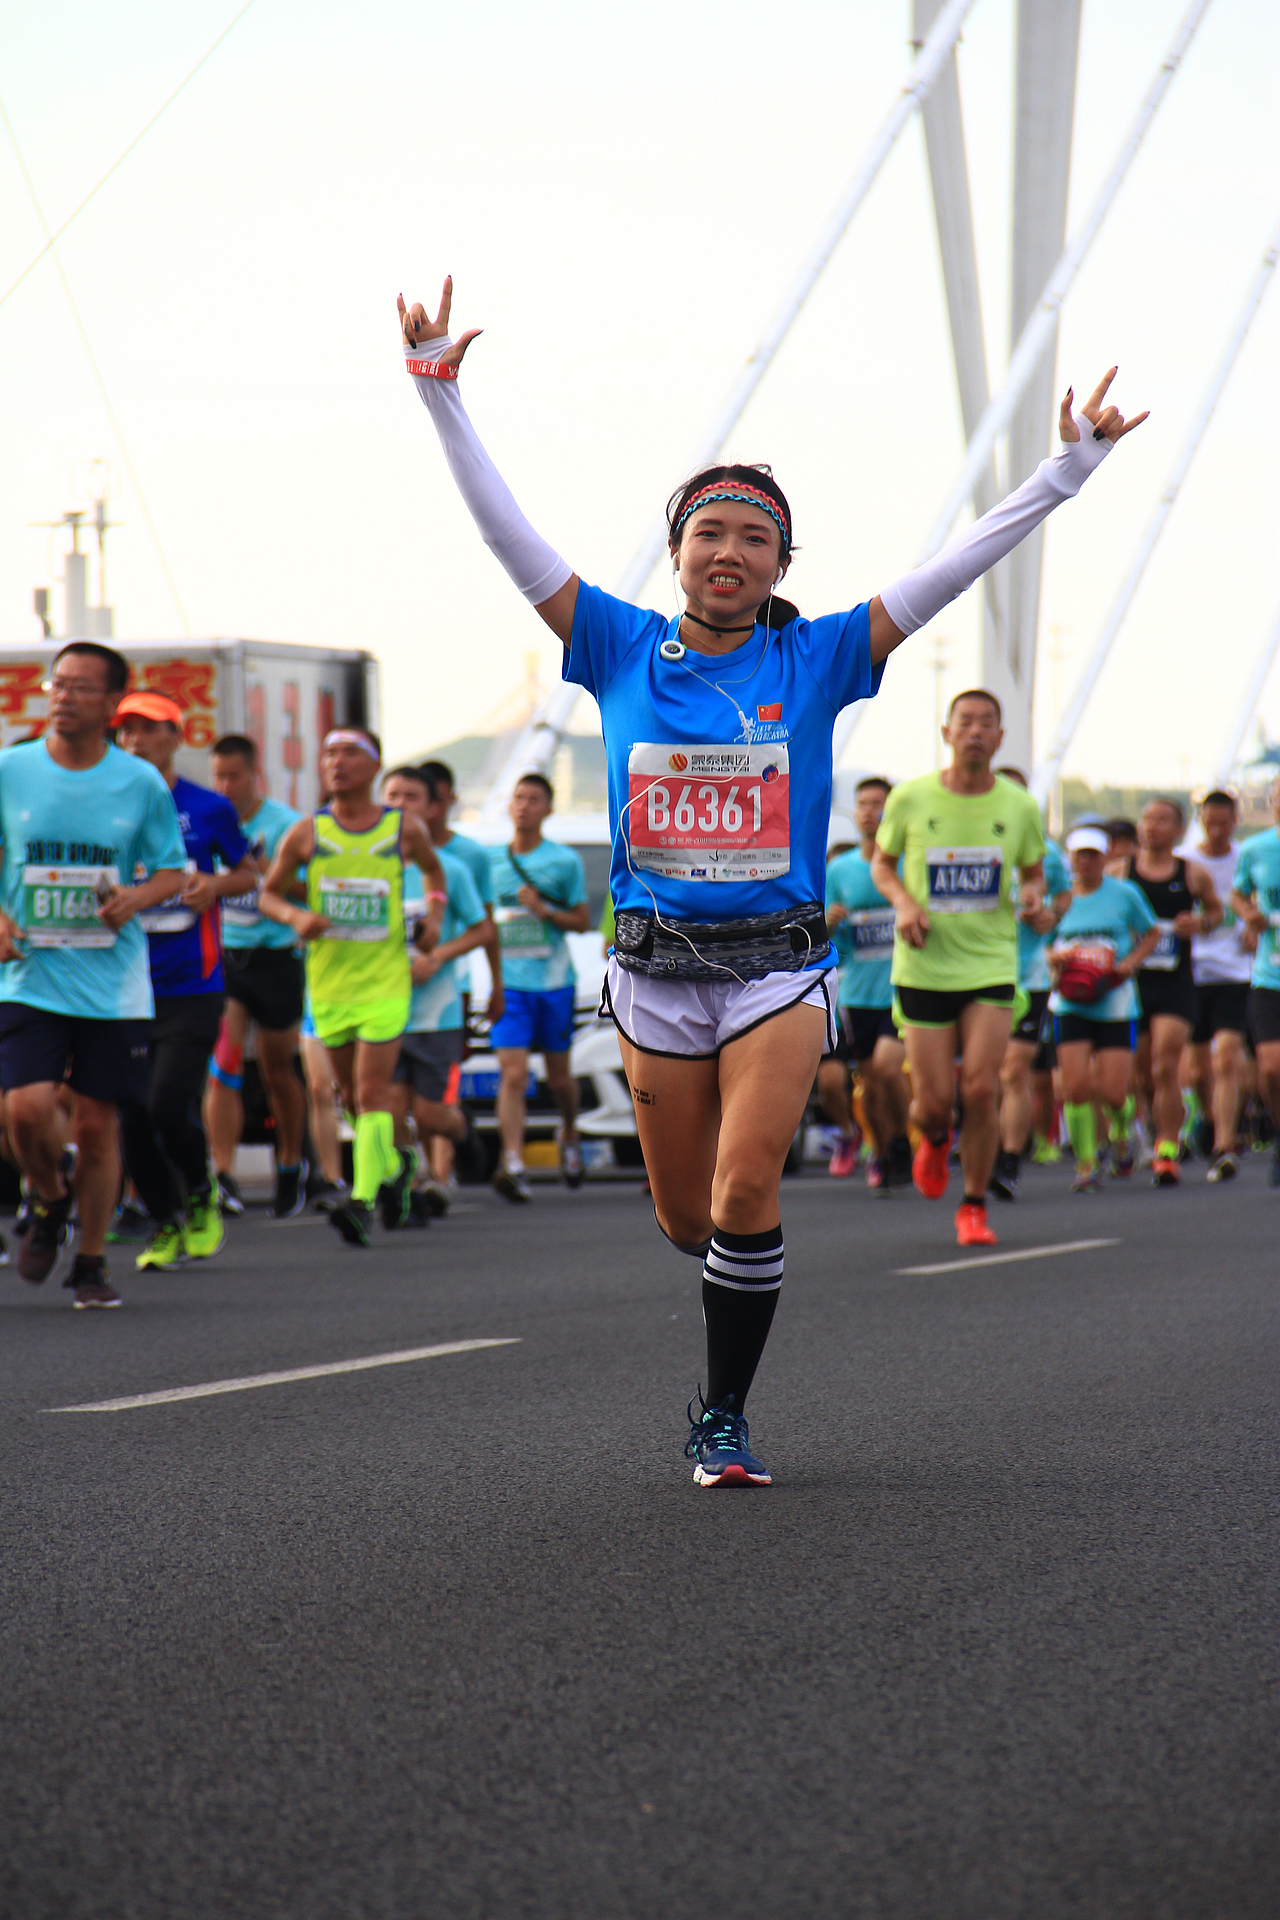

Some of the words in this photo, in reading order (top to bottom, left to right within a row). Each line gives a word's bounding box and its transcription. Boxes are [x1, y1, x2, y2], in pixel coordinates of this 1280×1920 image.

[647, 784, 762, 832] B6361
[934, 865, 994, 891] A1439
[325, 893, 380, 920] B2213
